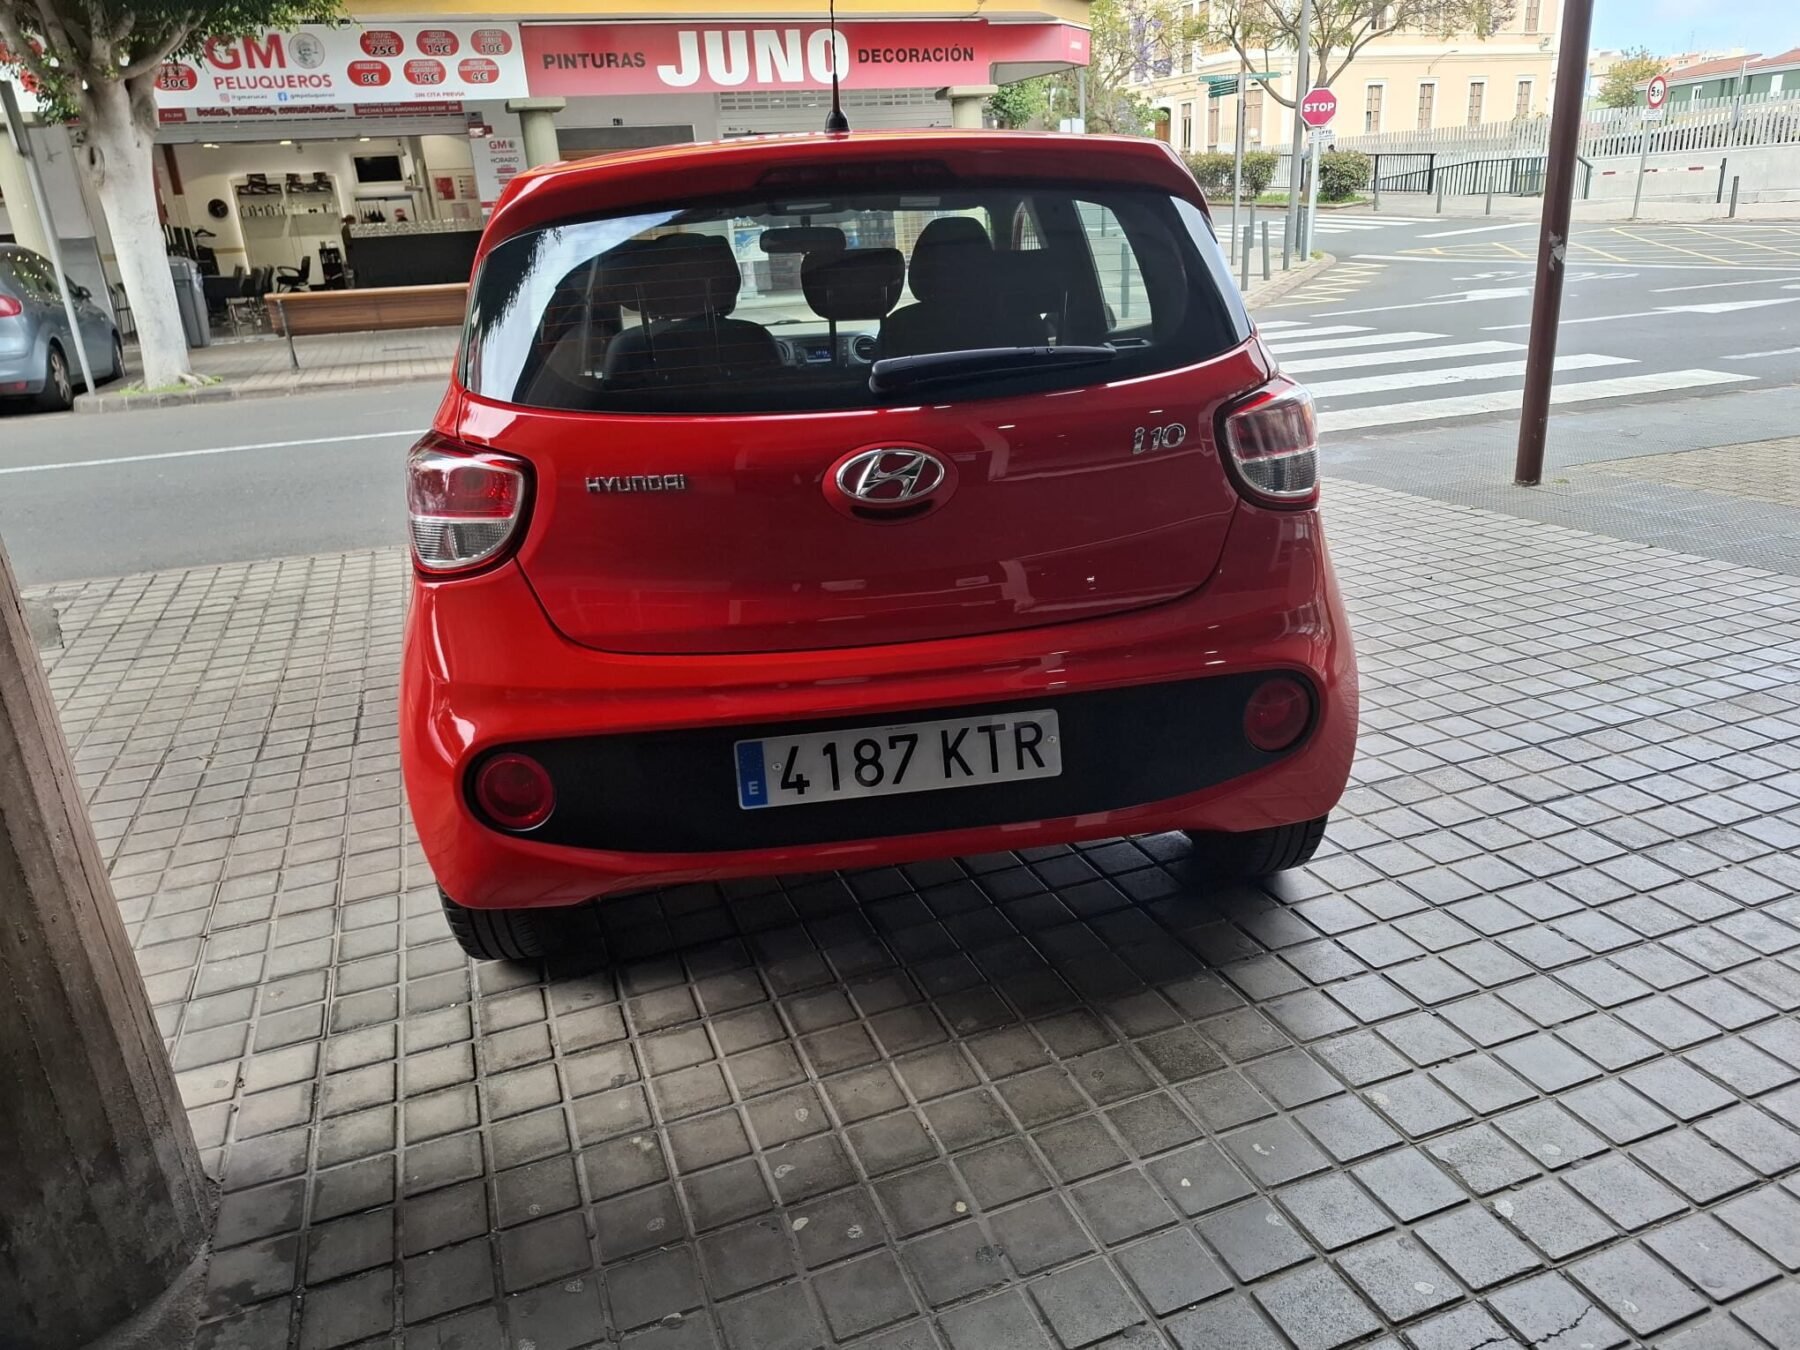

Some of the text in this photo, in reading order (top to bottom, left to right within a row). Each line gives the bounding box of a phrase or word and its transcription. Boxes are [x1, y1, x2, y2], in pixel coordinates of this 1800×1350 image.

[204, 33, 287, 70] GM
[371, 46, 396, 55] 25€
[427, 44, 451, 54] 14€
[481, 43, 503, 53] 10€
[657, 28, 849, 87] JUNO
[857, 44, 974, 64] DECORACIÓN
[542, 52, 646, 69] PINTURAS
[213, 74, 333, 90] PELUQUEROS
[362, 73, 378, 83] 8€
[415, 73, 439, 83] 14€
[472, 72, 487, 81] 4€
[1303, 102, 1335, 112] STOP
[488, 140, 507, 150] GM
[490, 156, 519, 164] HORARIO
[1133, 423, 1186, 455] i10
[585, 474, 685, 492] HYUNDAI
[780, 721, 1045, 795] 4187 KTR
[748, 781, 759, 794] E
